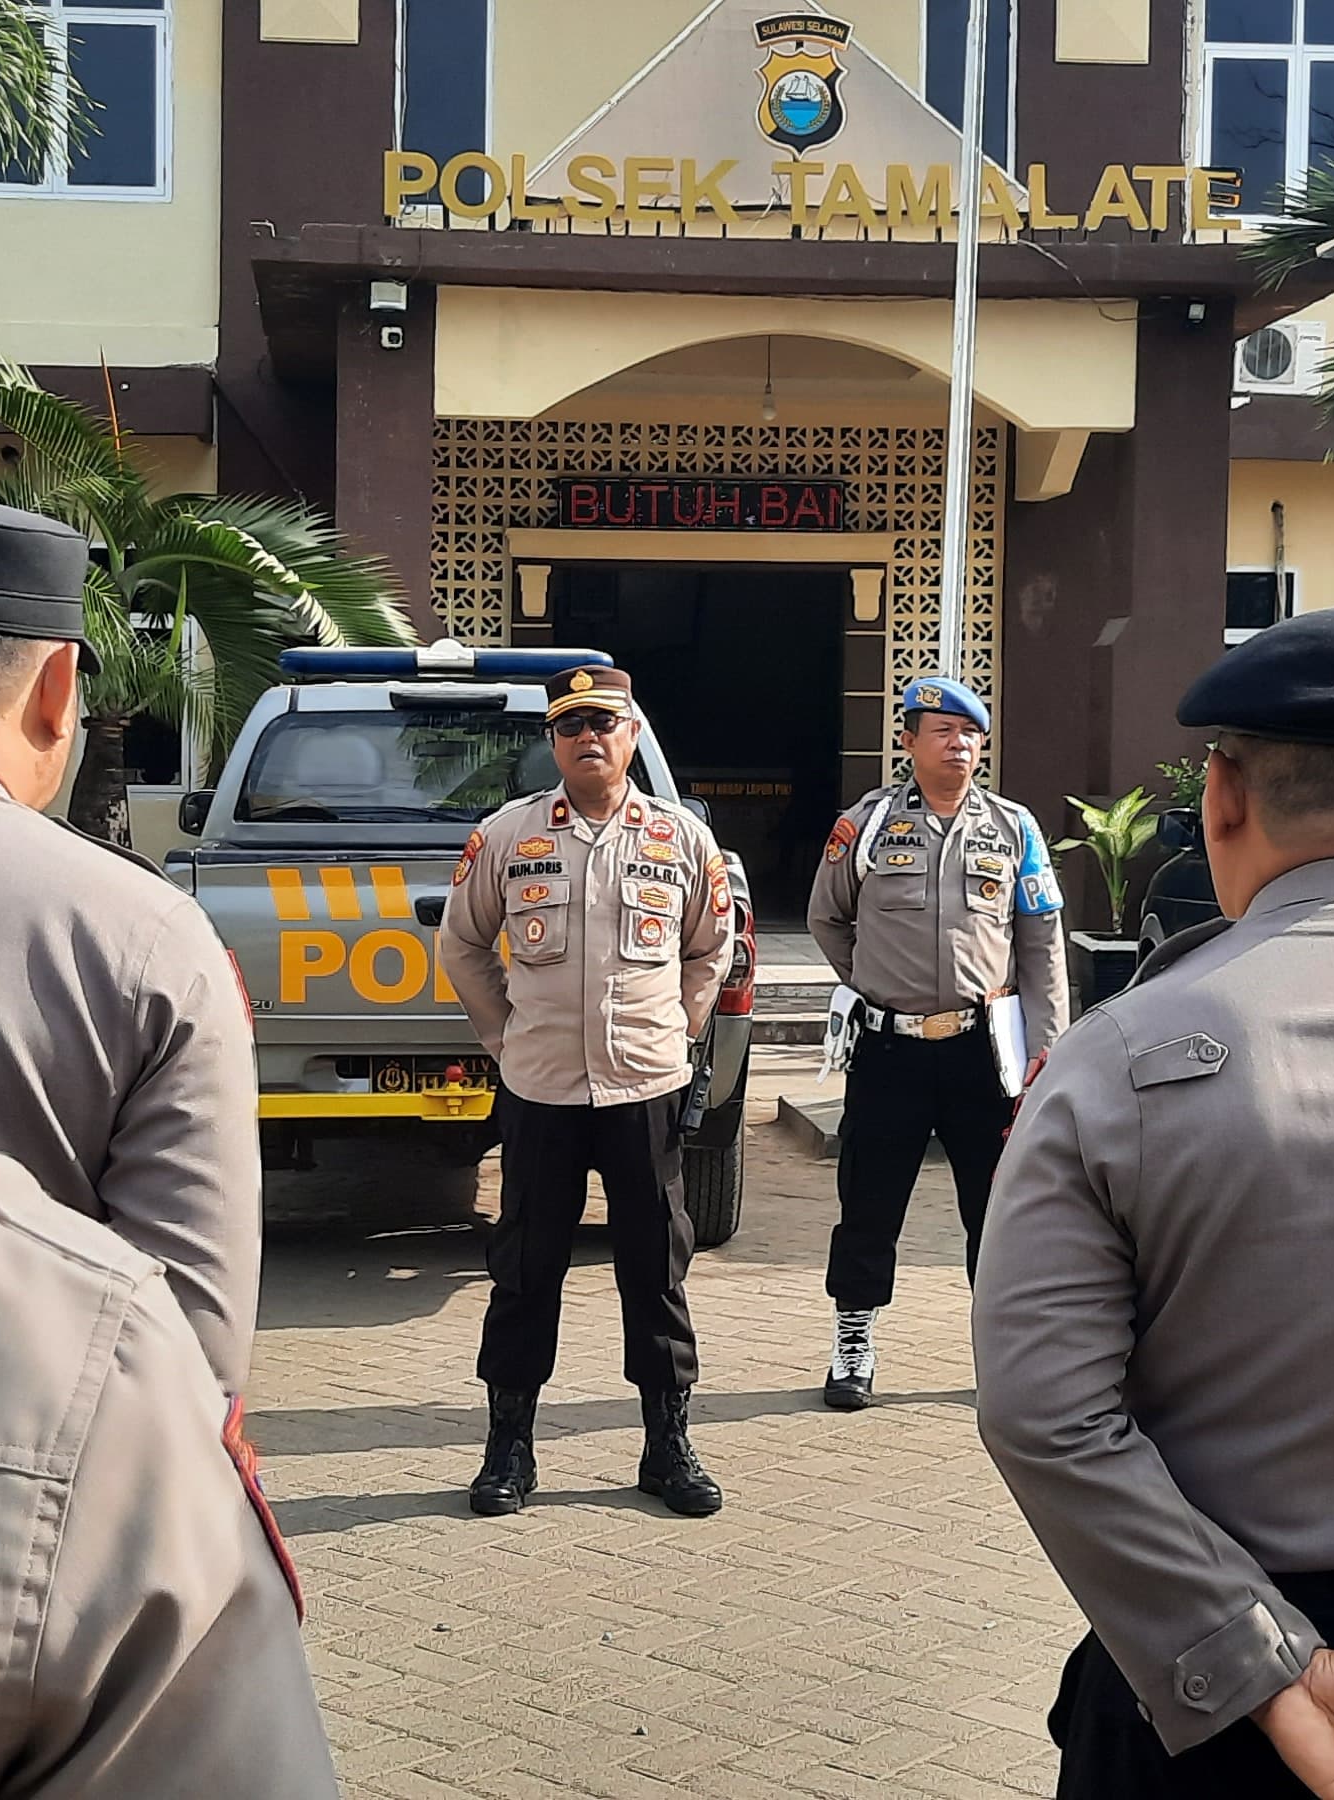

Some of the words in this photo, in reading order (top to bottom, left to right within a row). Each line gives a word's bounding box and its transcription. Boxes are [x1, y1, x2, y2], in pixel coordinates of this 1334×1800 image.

[761, 20, 805, 37] SULAWESI
[806, 20, 845, 39] SELATAN
[382, 150, 743, 225] POLSEK
[770, 163, 1243, 232] TAMALATE
[570, 484, 741, 525] BUTUH
[626, 862, 678, 884] POLRI
